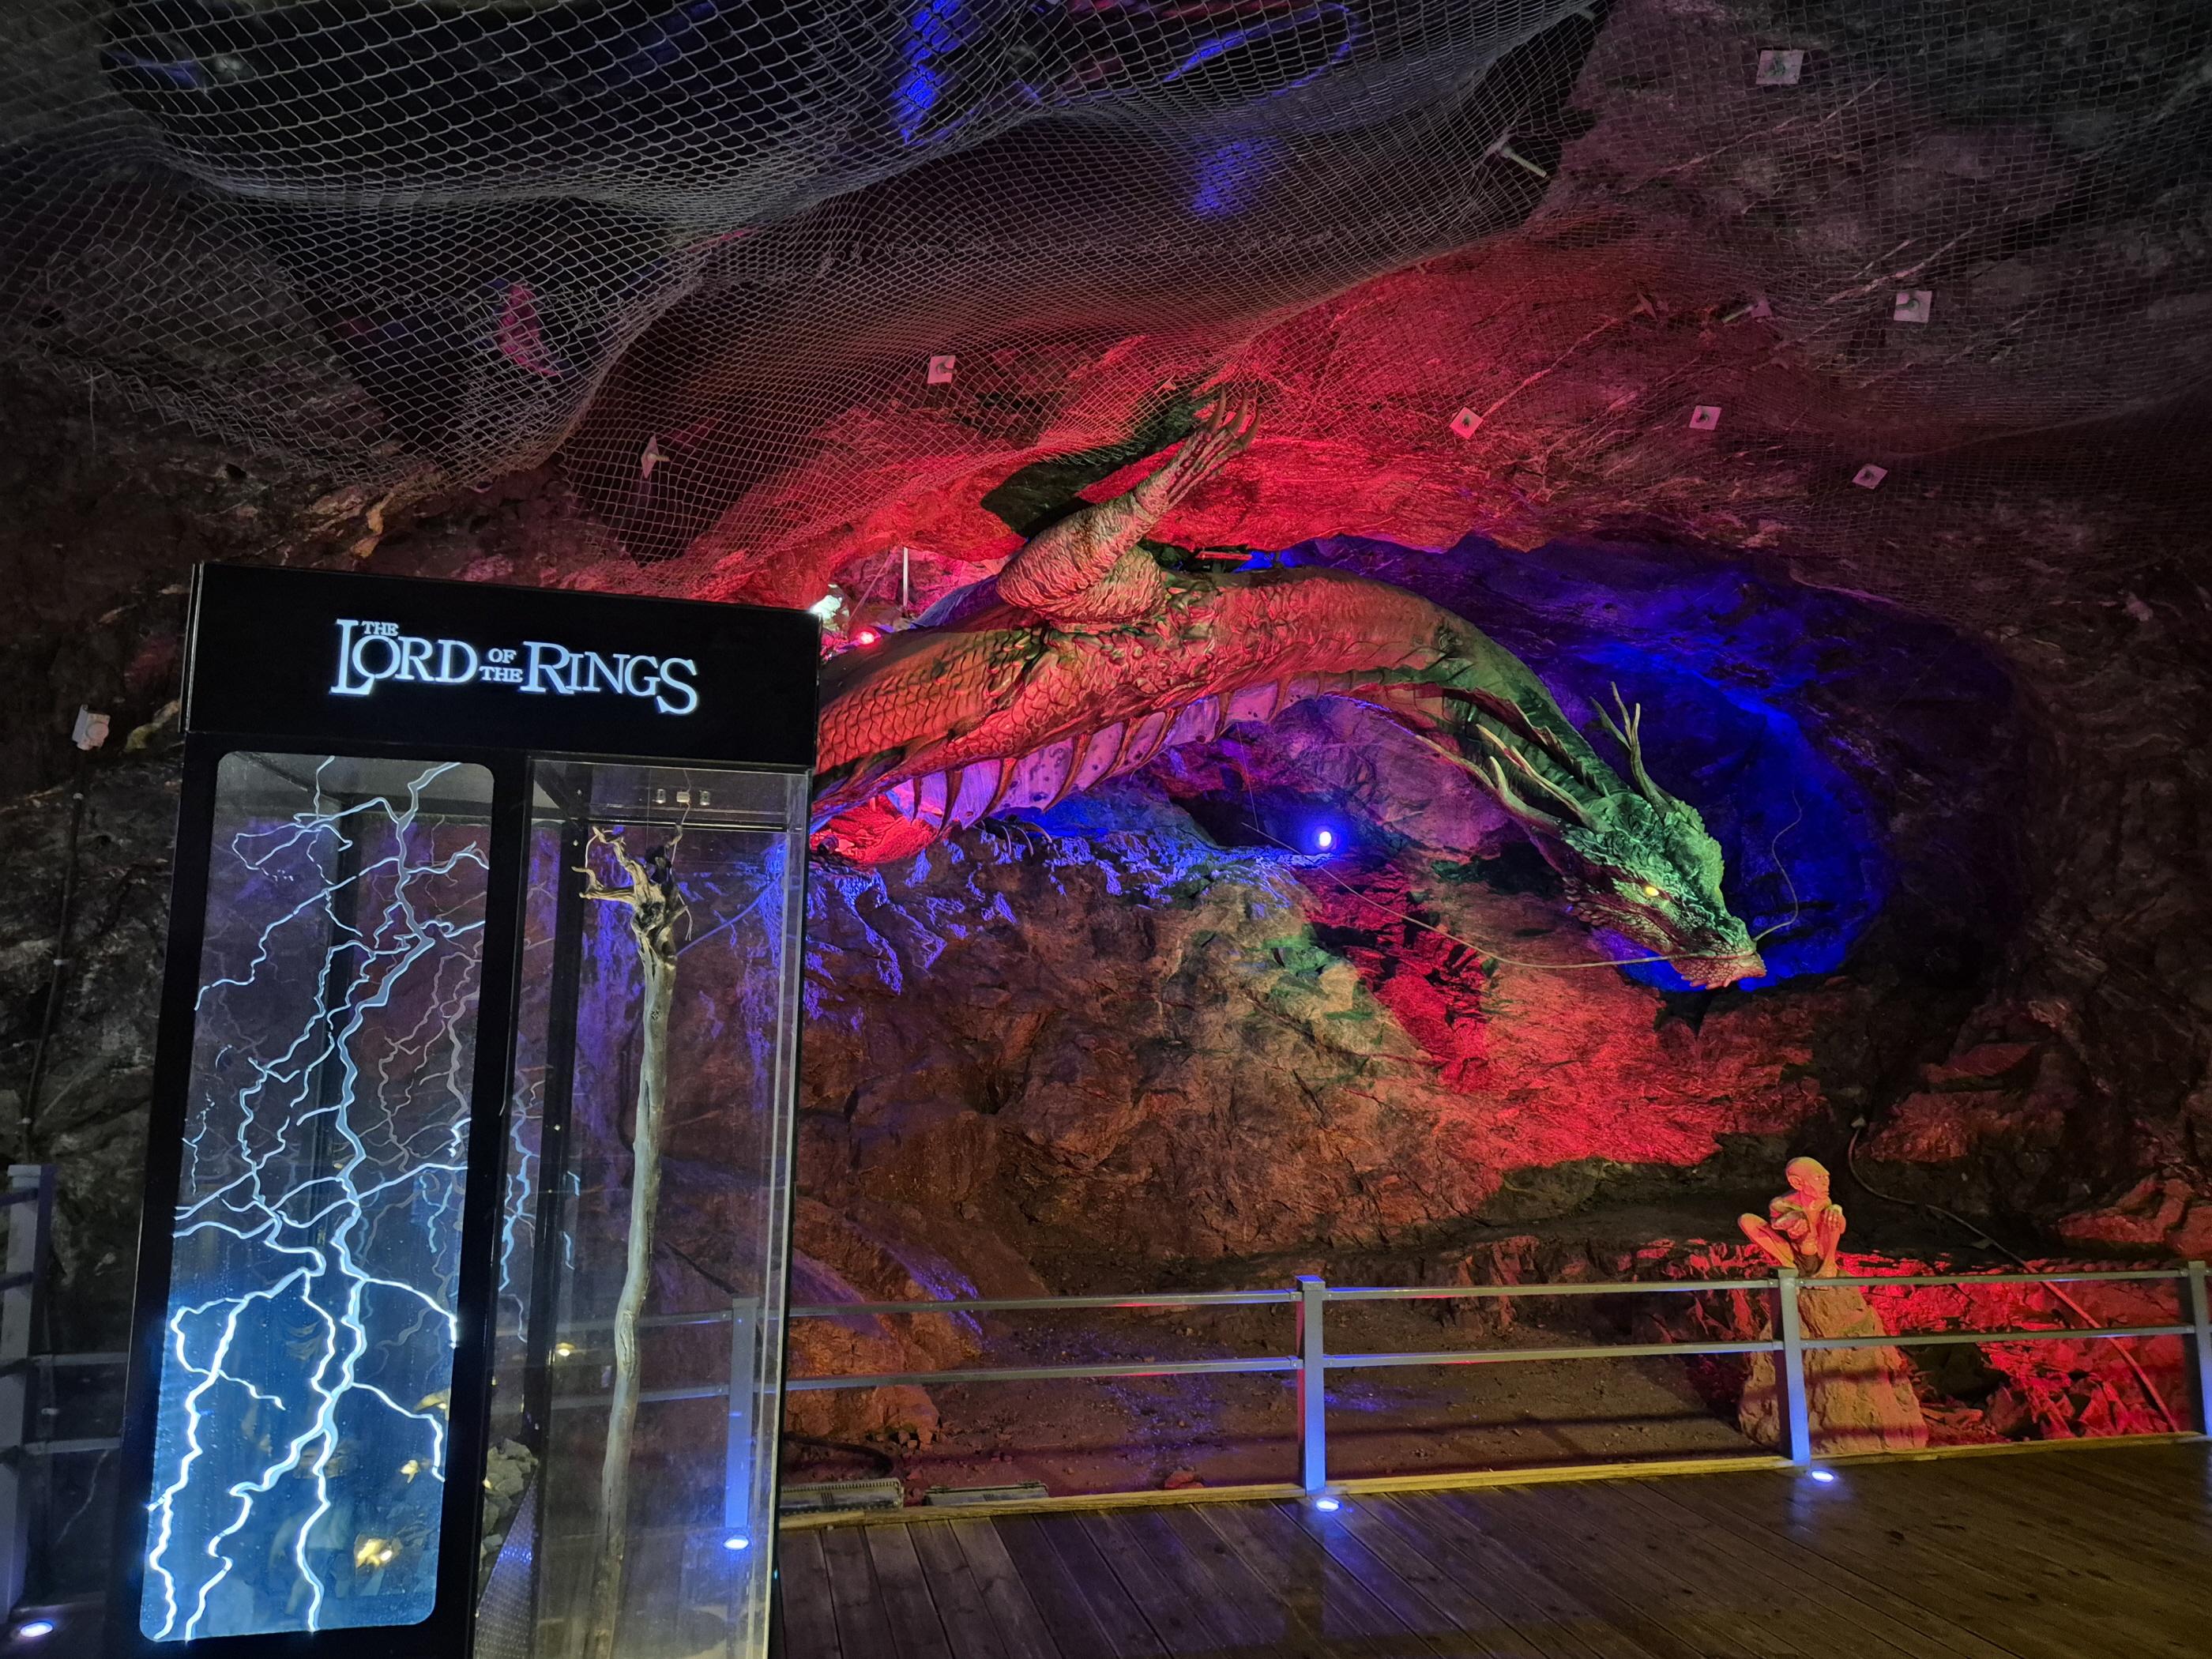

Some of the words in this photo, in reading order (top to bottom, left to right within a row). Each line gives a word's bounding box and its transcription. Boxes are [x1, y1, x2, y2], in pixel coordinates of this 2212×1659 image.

[361, 621, 399, 637] THE
[329, 619, 478, 696] LORD
[487, 648, 517, 664] OF
[479, 666, 524, 684] THE
[519, 641, 699, 715] RINGS
